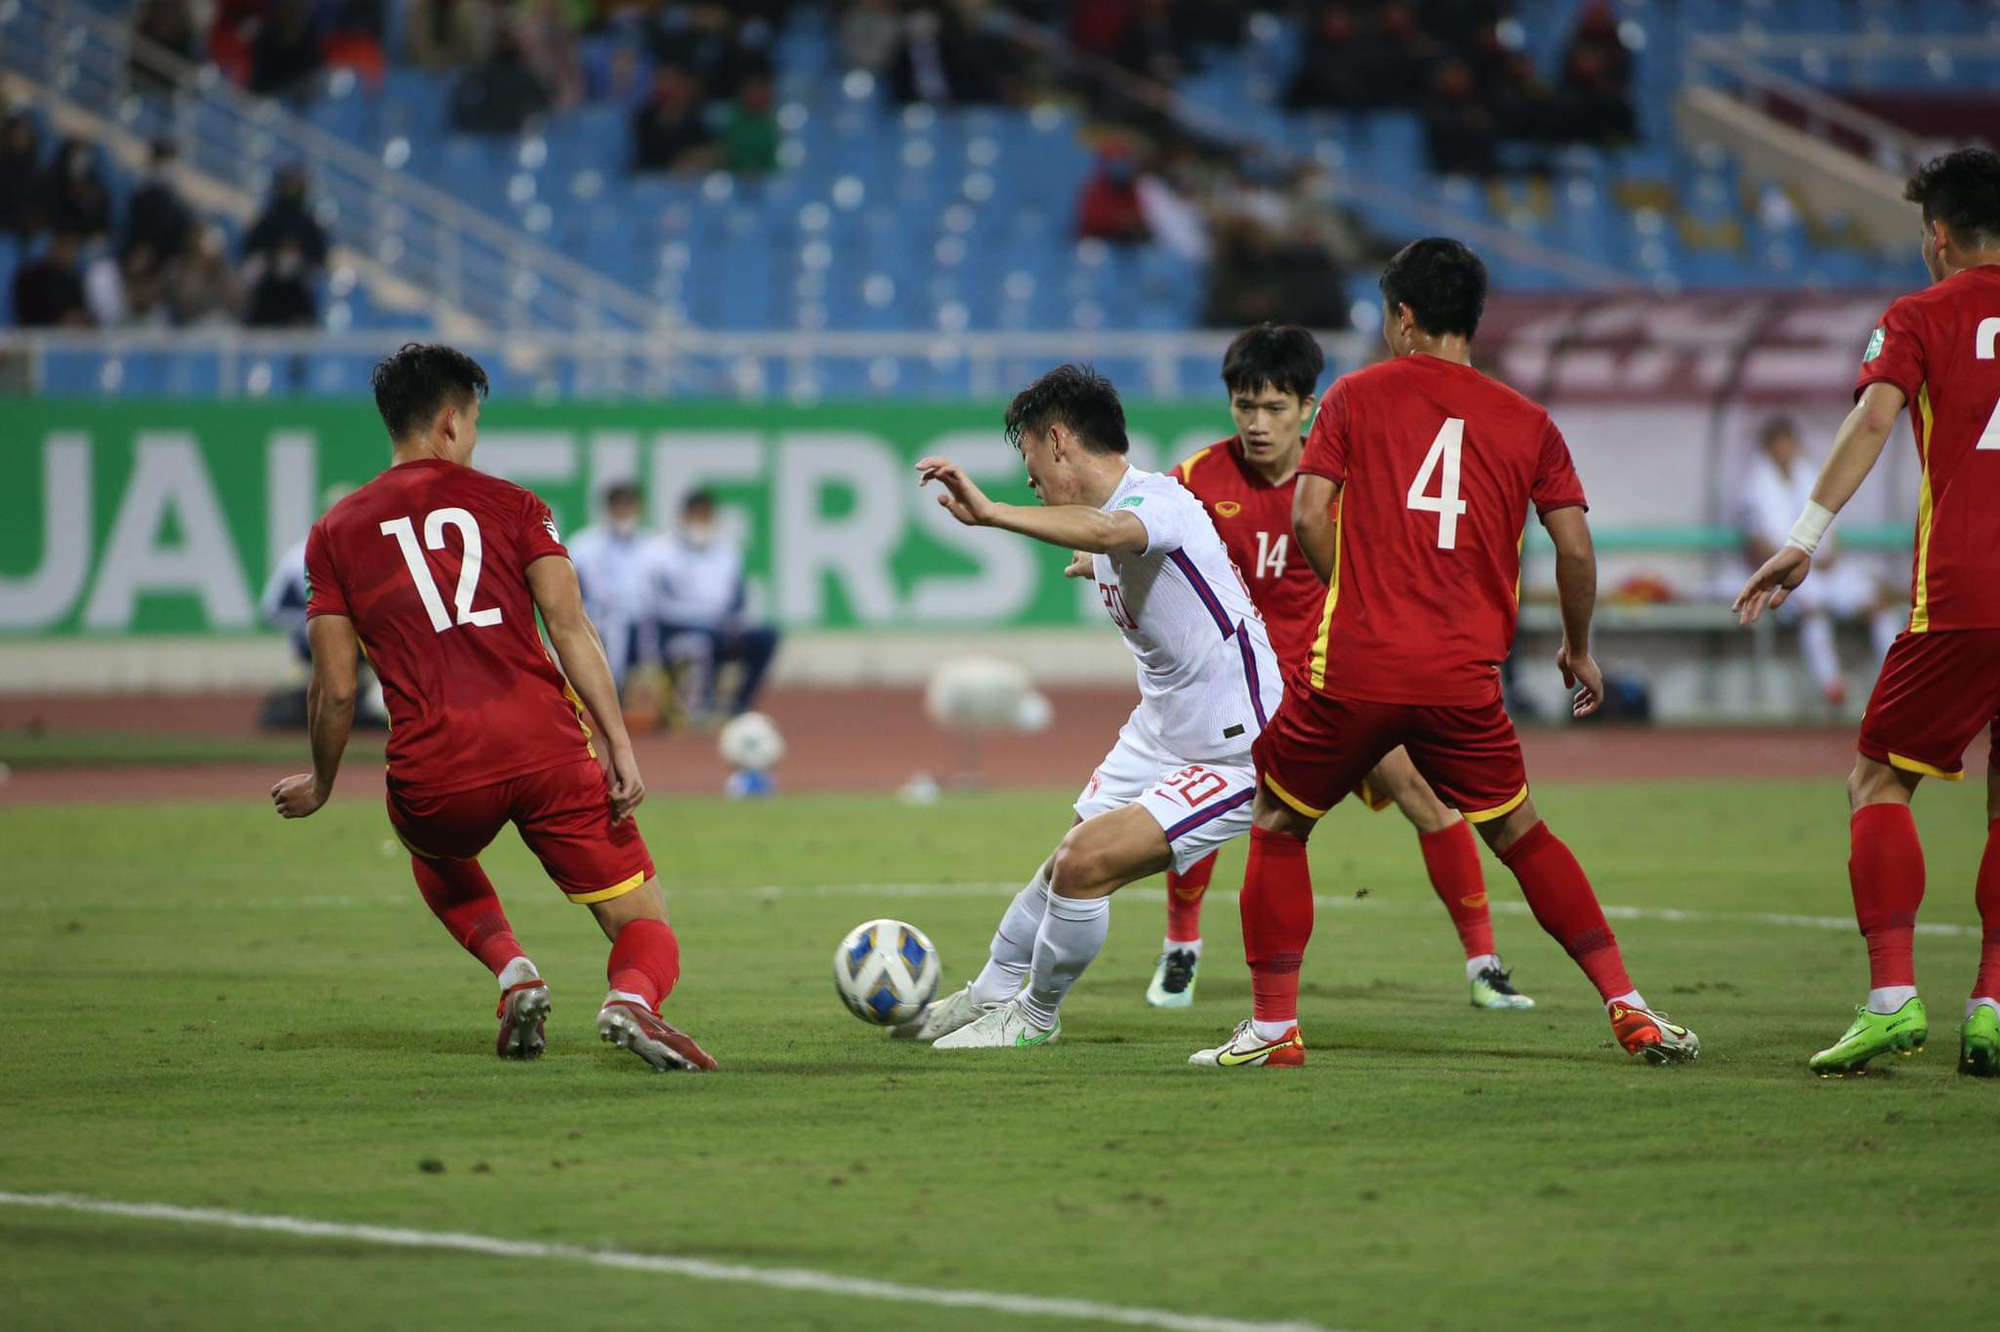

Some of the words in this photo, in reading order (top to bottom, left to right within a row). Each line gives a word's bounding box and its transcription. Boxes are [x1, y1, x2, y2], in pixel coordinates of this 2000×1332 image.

[1406, 417, 1467, 550] 4
[379, 507, 503, 633] 12
[1255, 530, 1289, 578] 14
[1163, 765, 1229, 808] 20
